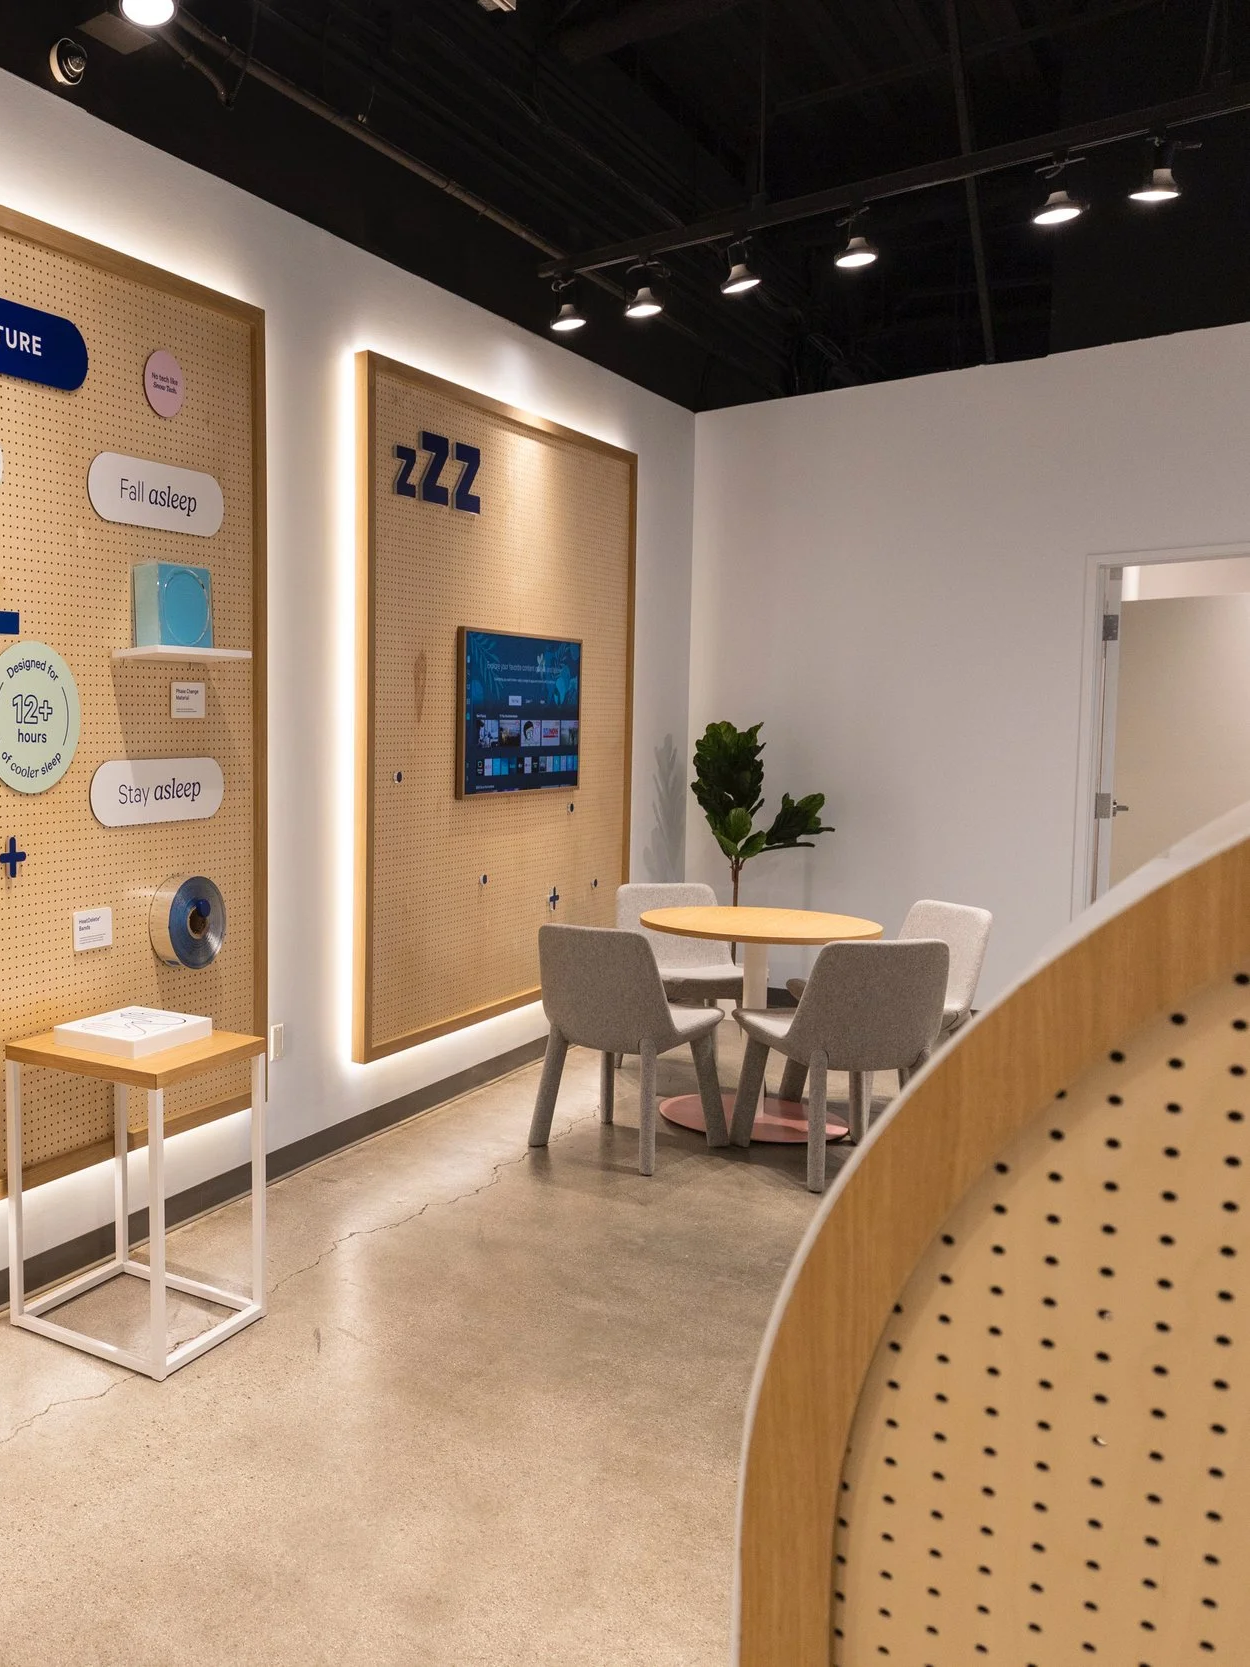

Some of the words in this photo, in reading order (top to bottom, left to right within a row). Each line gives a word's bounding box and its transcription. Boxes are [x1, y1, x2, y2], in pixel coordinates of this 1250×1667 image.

[121, 478, 144, 502] Fall
[149, 486, 197, 516] asleep
[7, 658, 46, 679] Designed
[48, 665, 58, 681] for
[12, 694, 53, 724] 12+
[17, 729, 47, 743] hours
[1, 752, 12, 763] of
[10, 762, 39, 778] cooler
[41, 752, 62, 775] sleep
[118, 784, 150, 807] Stay
[154, 778, 201, 802] asleep
